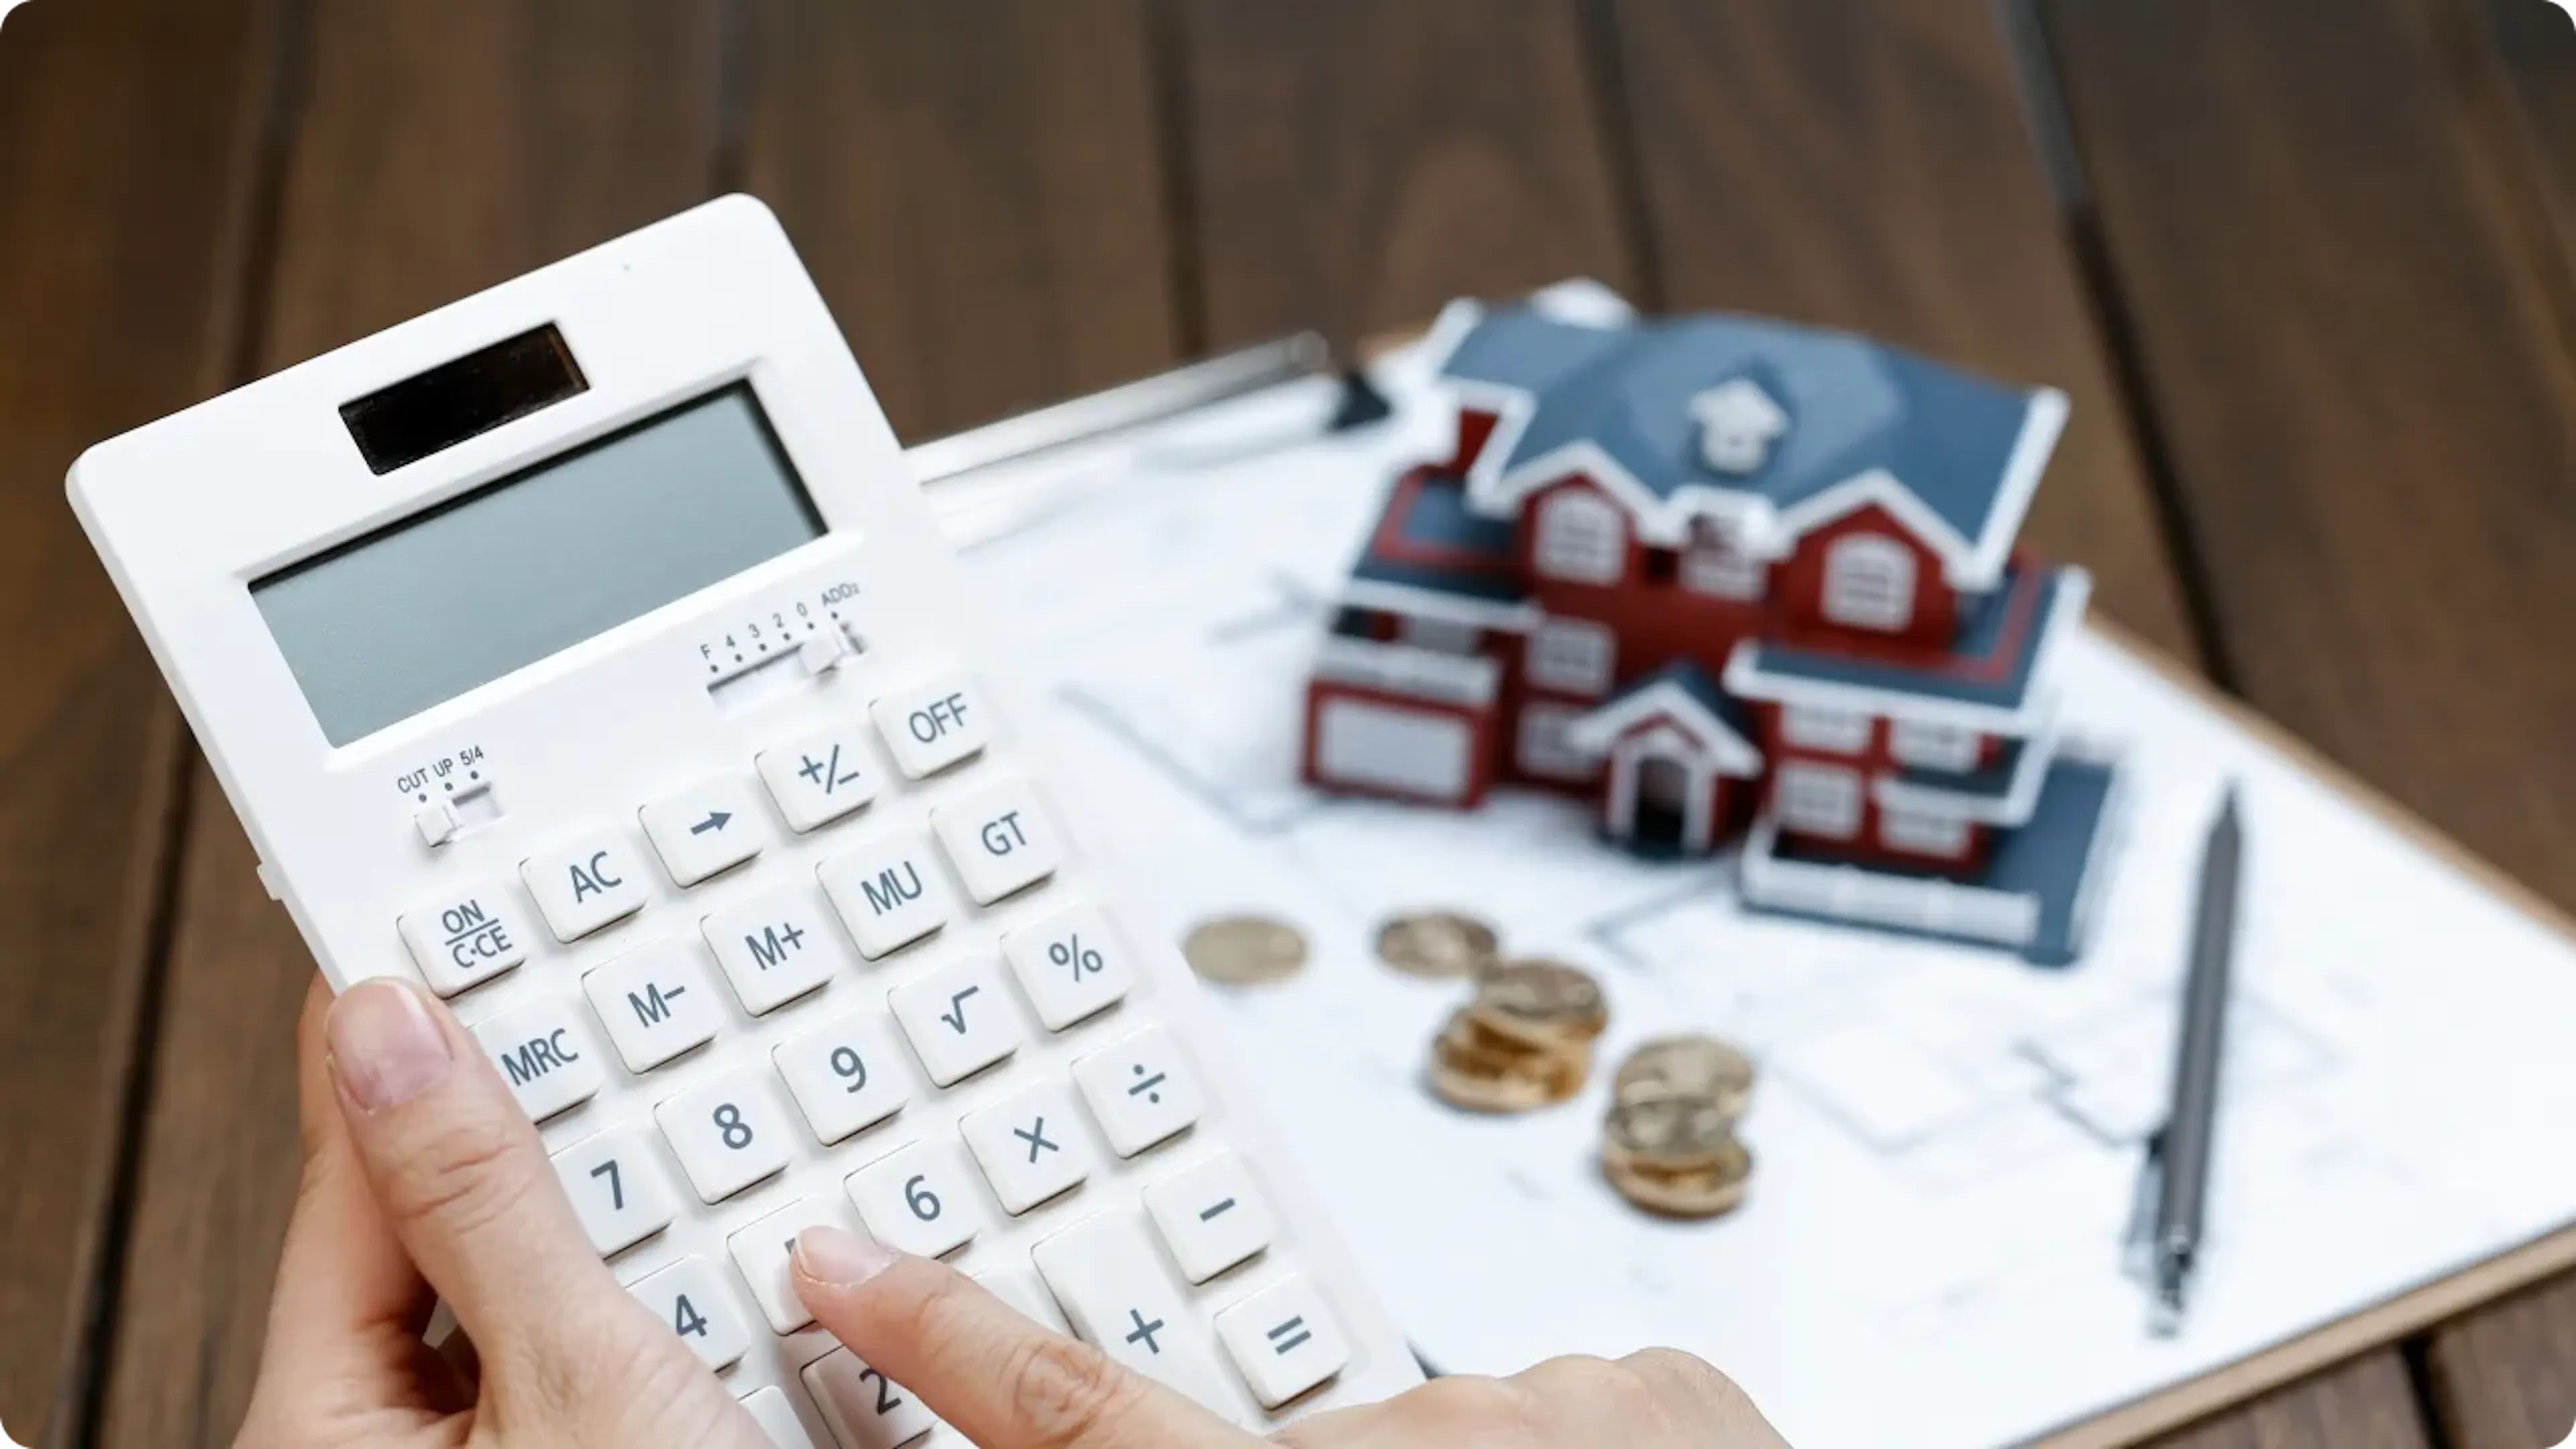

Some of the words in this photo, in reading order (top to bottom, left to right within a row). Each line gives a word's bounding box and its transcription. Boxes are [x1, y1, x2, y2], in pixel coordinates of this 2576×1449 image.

[700, 643, 710, 660] F
[726, 635, 736, 648] 4
[748, 623, 761, 639] 3
[772, 612, 784, 629] 2
[909, 693, 966, 743] OFF
[397, 767, 429, 794] CUT
[432, 758, 453, 777] UP
[459, 745, 484, 766] 5/4
[981, 812, 1026, 856] GT
[570, 851, 623, 904] AC
[861, 861, 922, 916] MU
[442, 899, 486, 934] ON
[745, 923, 804, 970] M+
[501, 1028, 578, 1087] MRC
[830, 1046, 866, 1093] 9
[712, 1104, 753, 1150] 8
[590, 1159, 624, 1210] 7
[905, 1175, 941, 1221] 6
[676, 1294, 707, 1337] 4
[859, 1368, 902, 1416] 2
